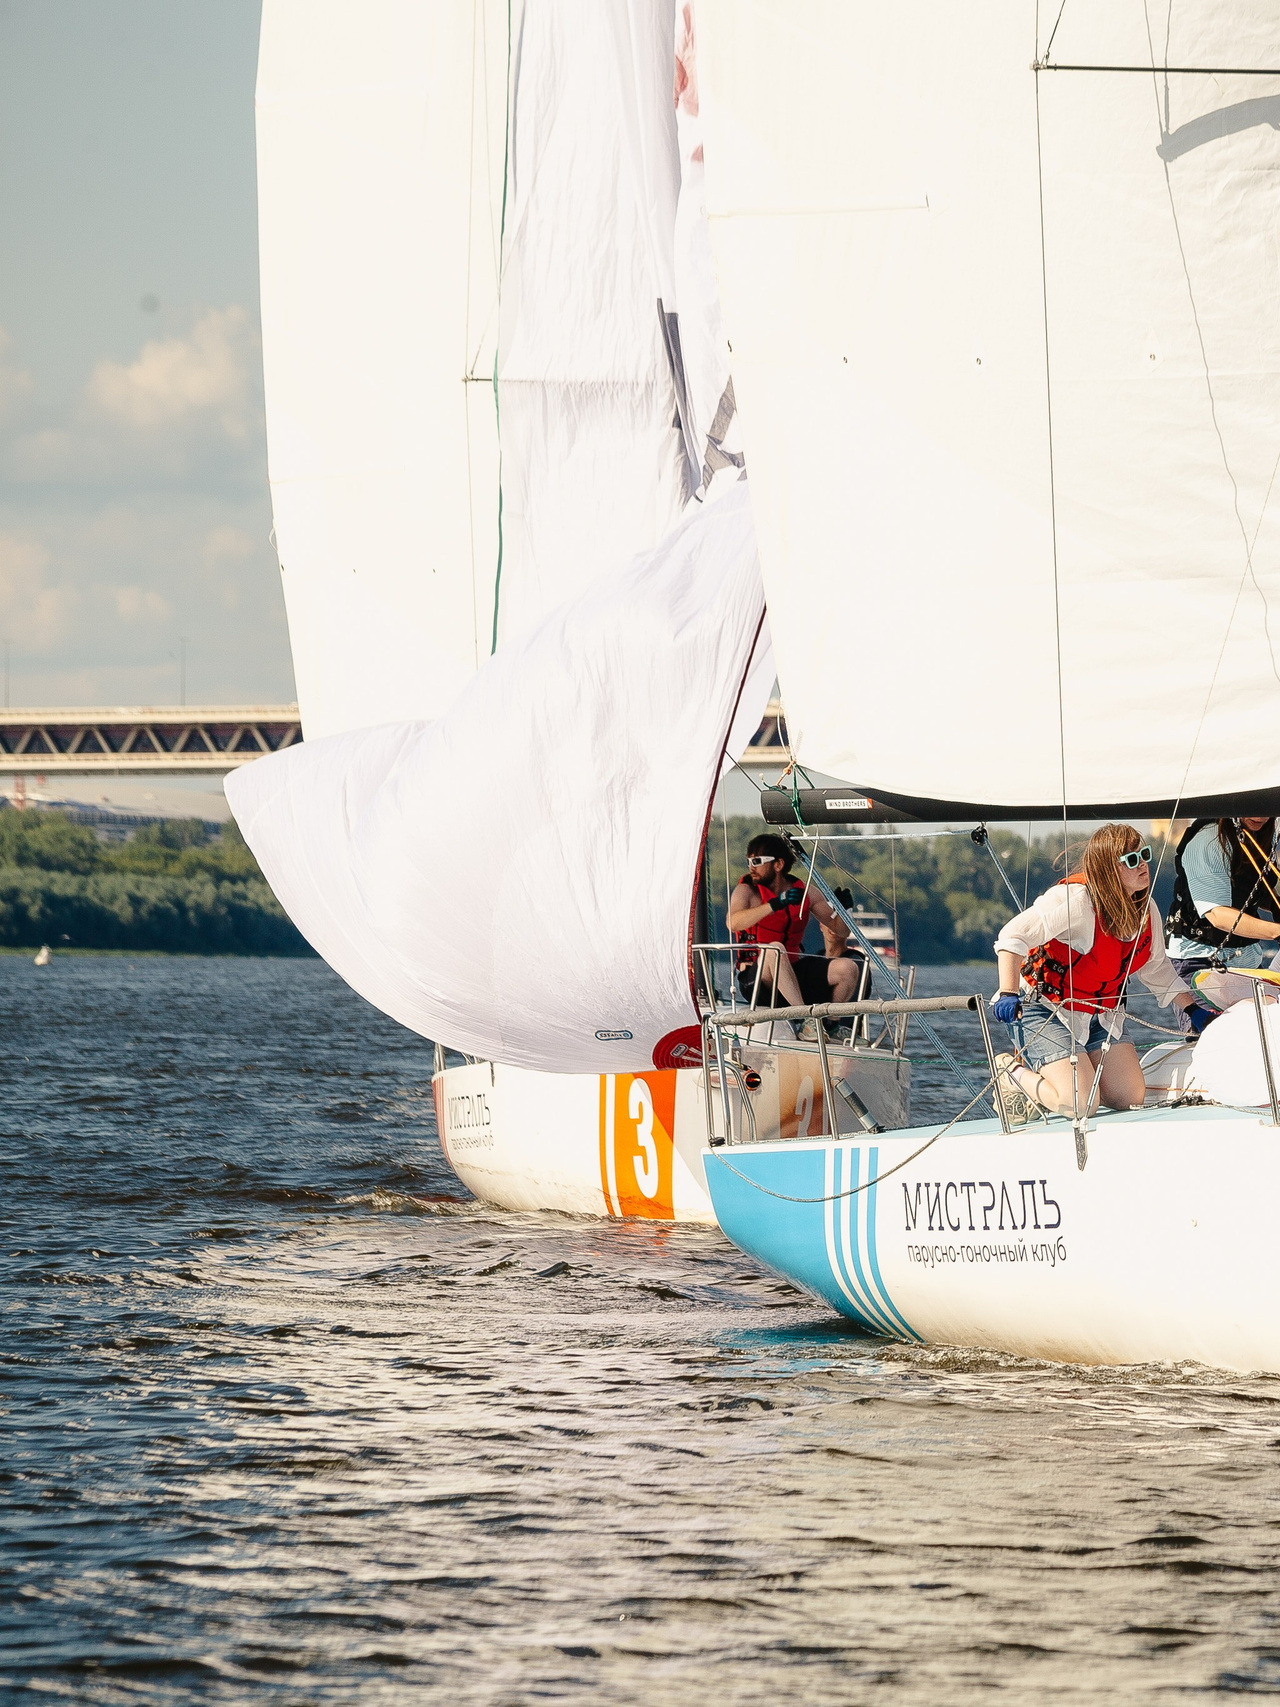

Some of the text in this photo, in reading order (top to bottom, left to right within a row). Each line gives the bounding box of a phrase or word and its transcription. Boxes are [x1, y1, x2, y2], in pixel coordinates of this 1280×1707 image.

[628, 1077, 659, 1199] 3
[902, 1179, 1062, 1231] МИСТРАЛЬ
[907, 1235, 1067, 1268] парусно-гоночный клуб
